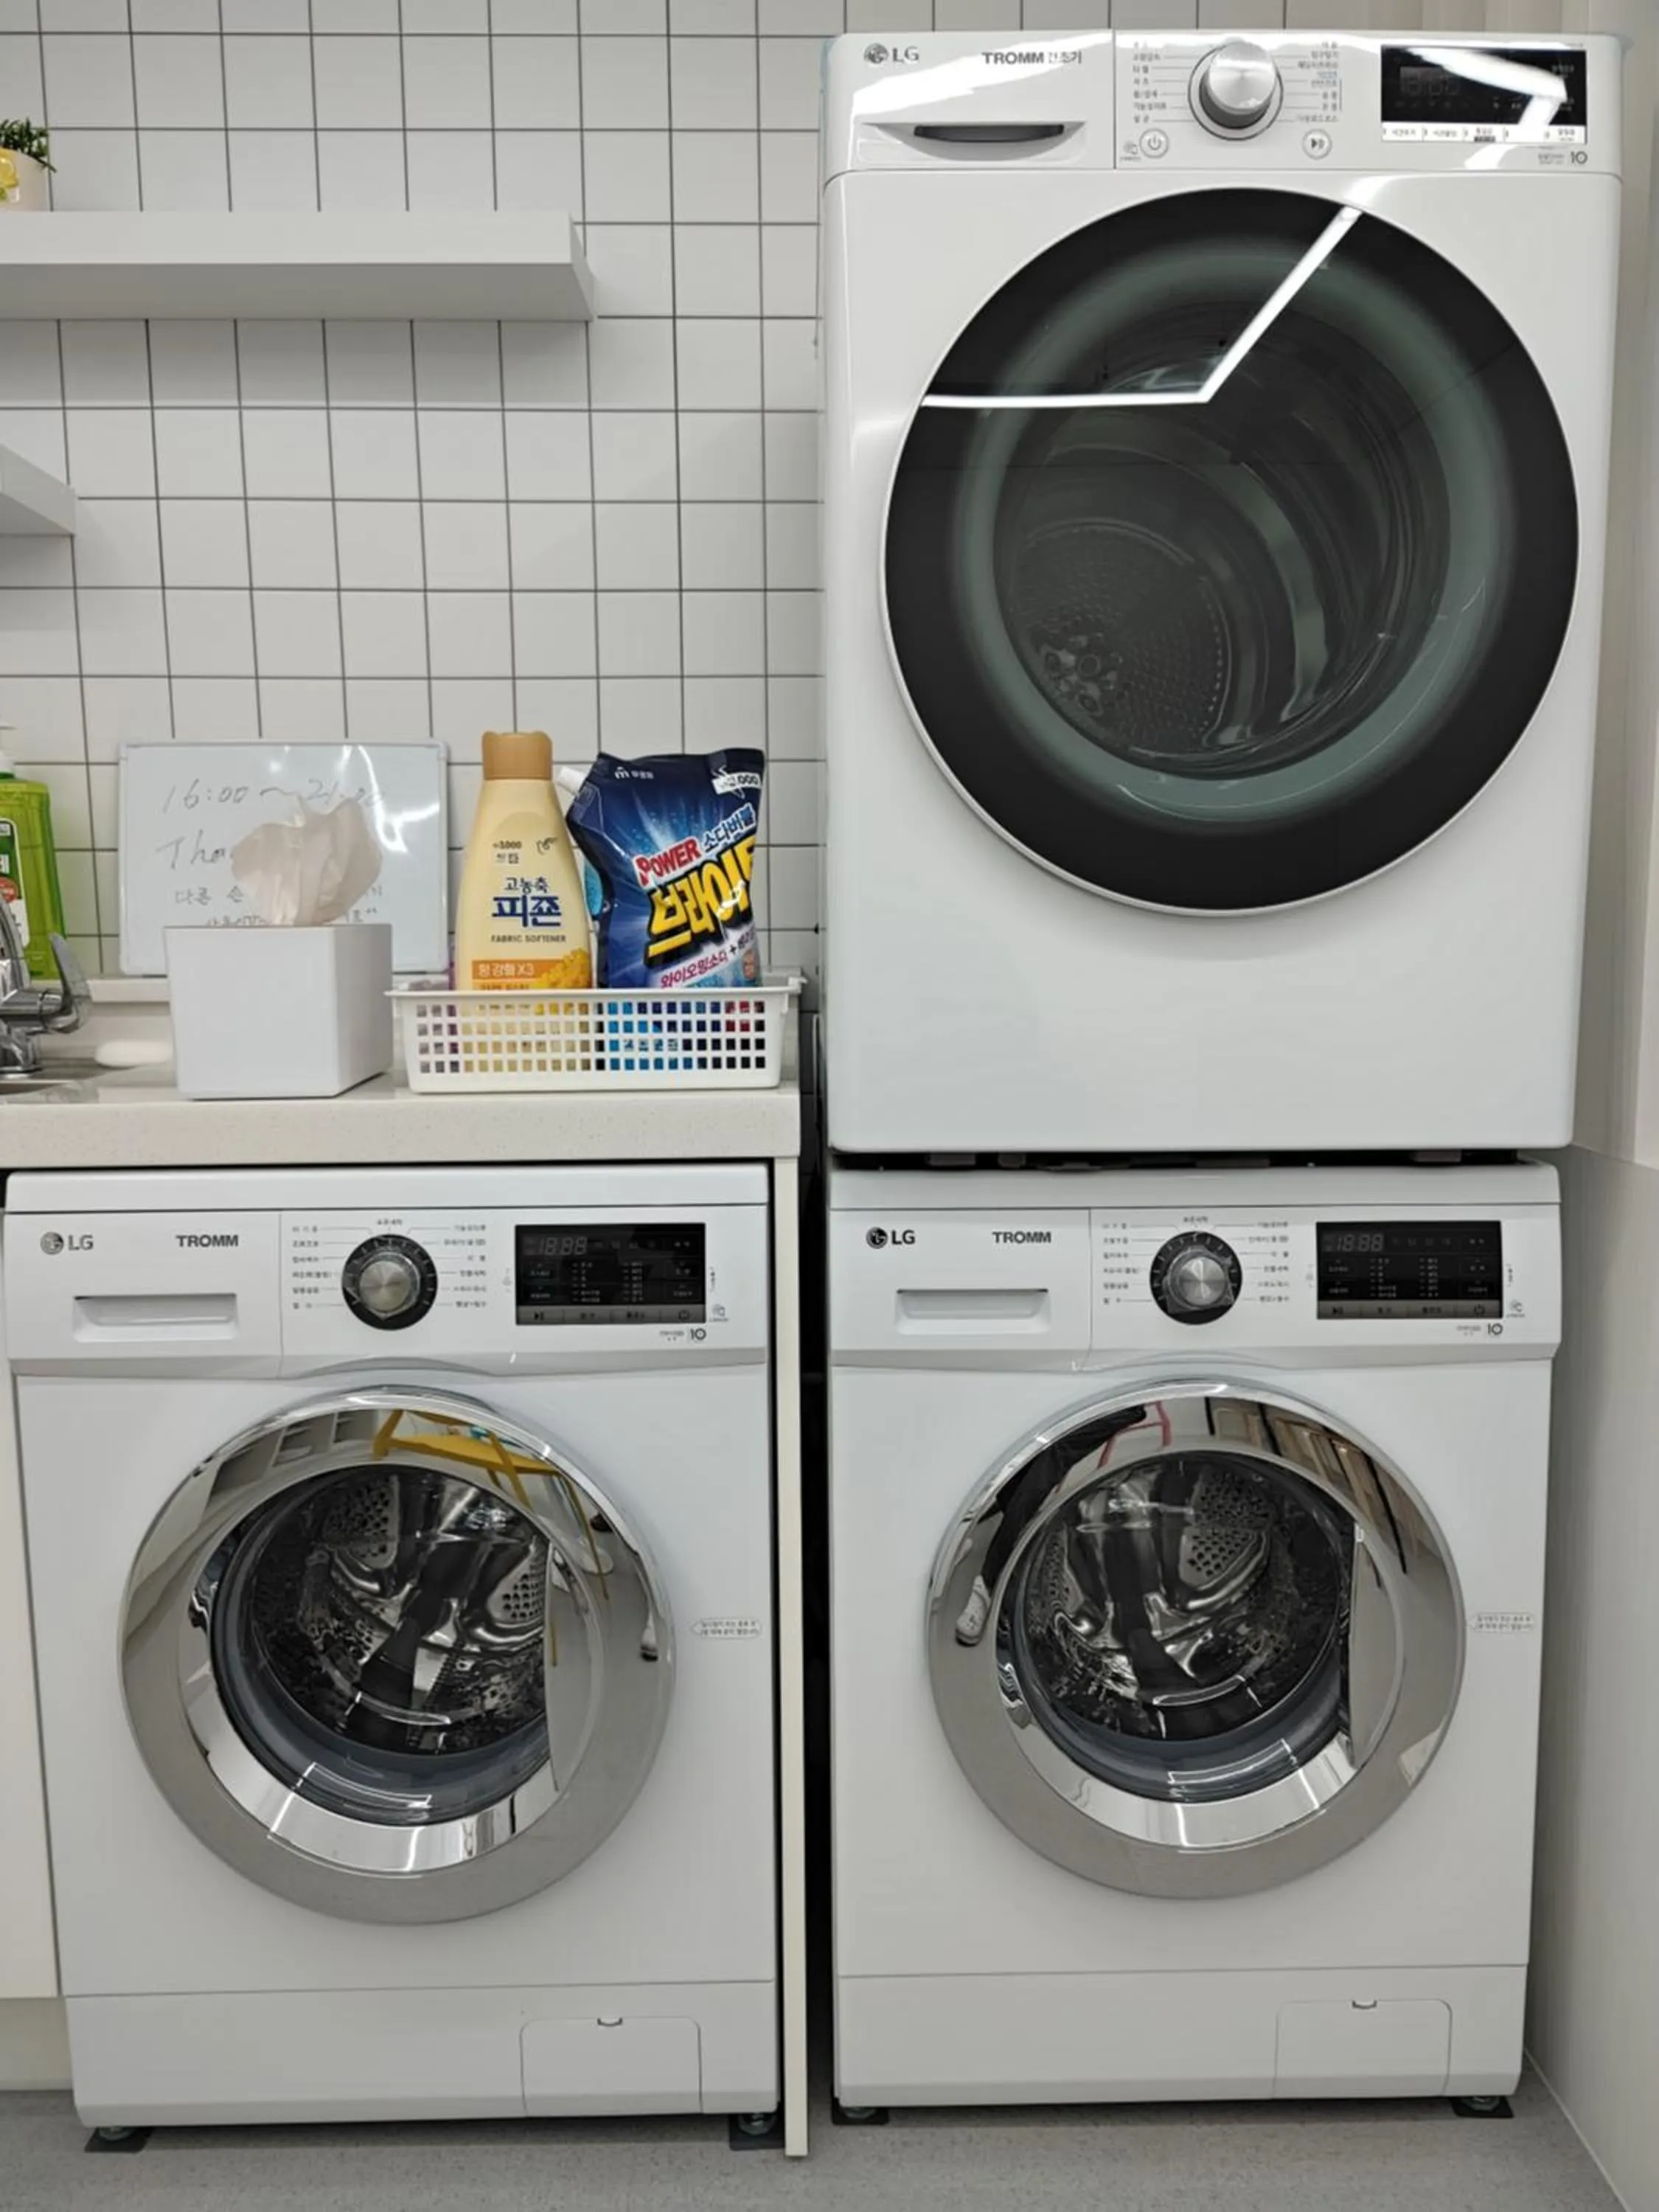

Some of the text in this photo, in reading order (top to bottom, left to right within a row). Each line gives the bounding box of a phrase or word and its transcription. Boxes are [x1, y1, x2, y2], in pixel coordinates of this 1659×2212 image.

[891, 46, 919, 63] LG
[981, 51, 1044, 65] TROMM
[1570, 150, 1587, 164] 10
[163, 779, 248, 813] 16:00
[636, 804, 756, 886] POWER 소다버블
[504, 876, 549, 894] 고농축
[492, 894, 562, 928] 피죤
[490, 934, 566, 943] FABRIC SOFTENER
[68, 1234, 94, 1251] LG
[175, 1234, 239, 1248] TROMM
[891, 1229, 916, 1245] LG
[992, 1231, 1051, 1245] TROMM
[690, 1326, 707, 1340] 10
[1487, 1323, 1503, 1335] 10
